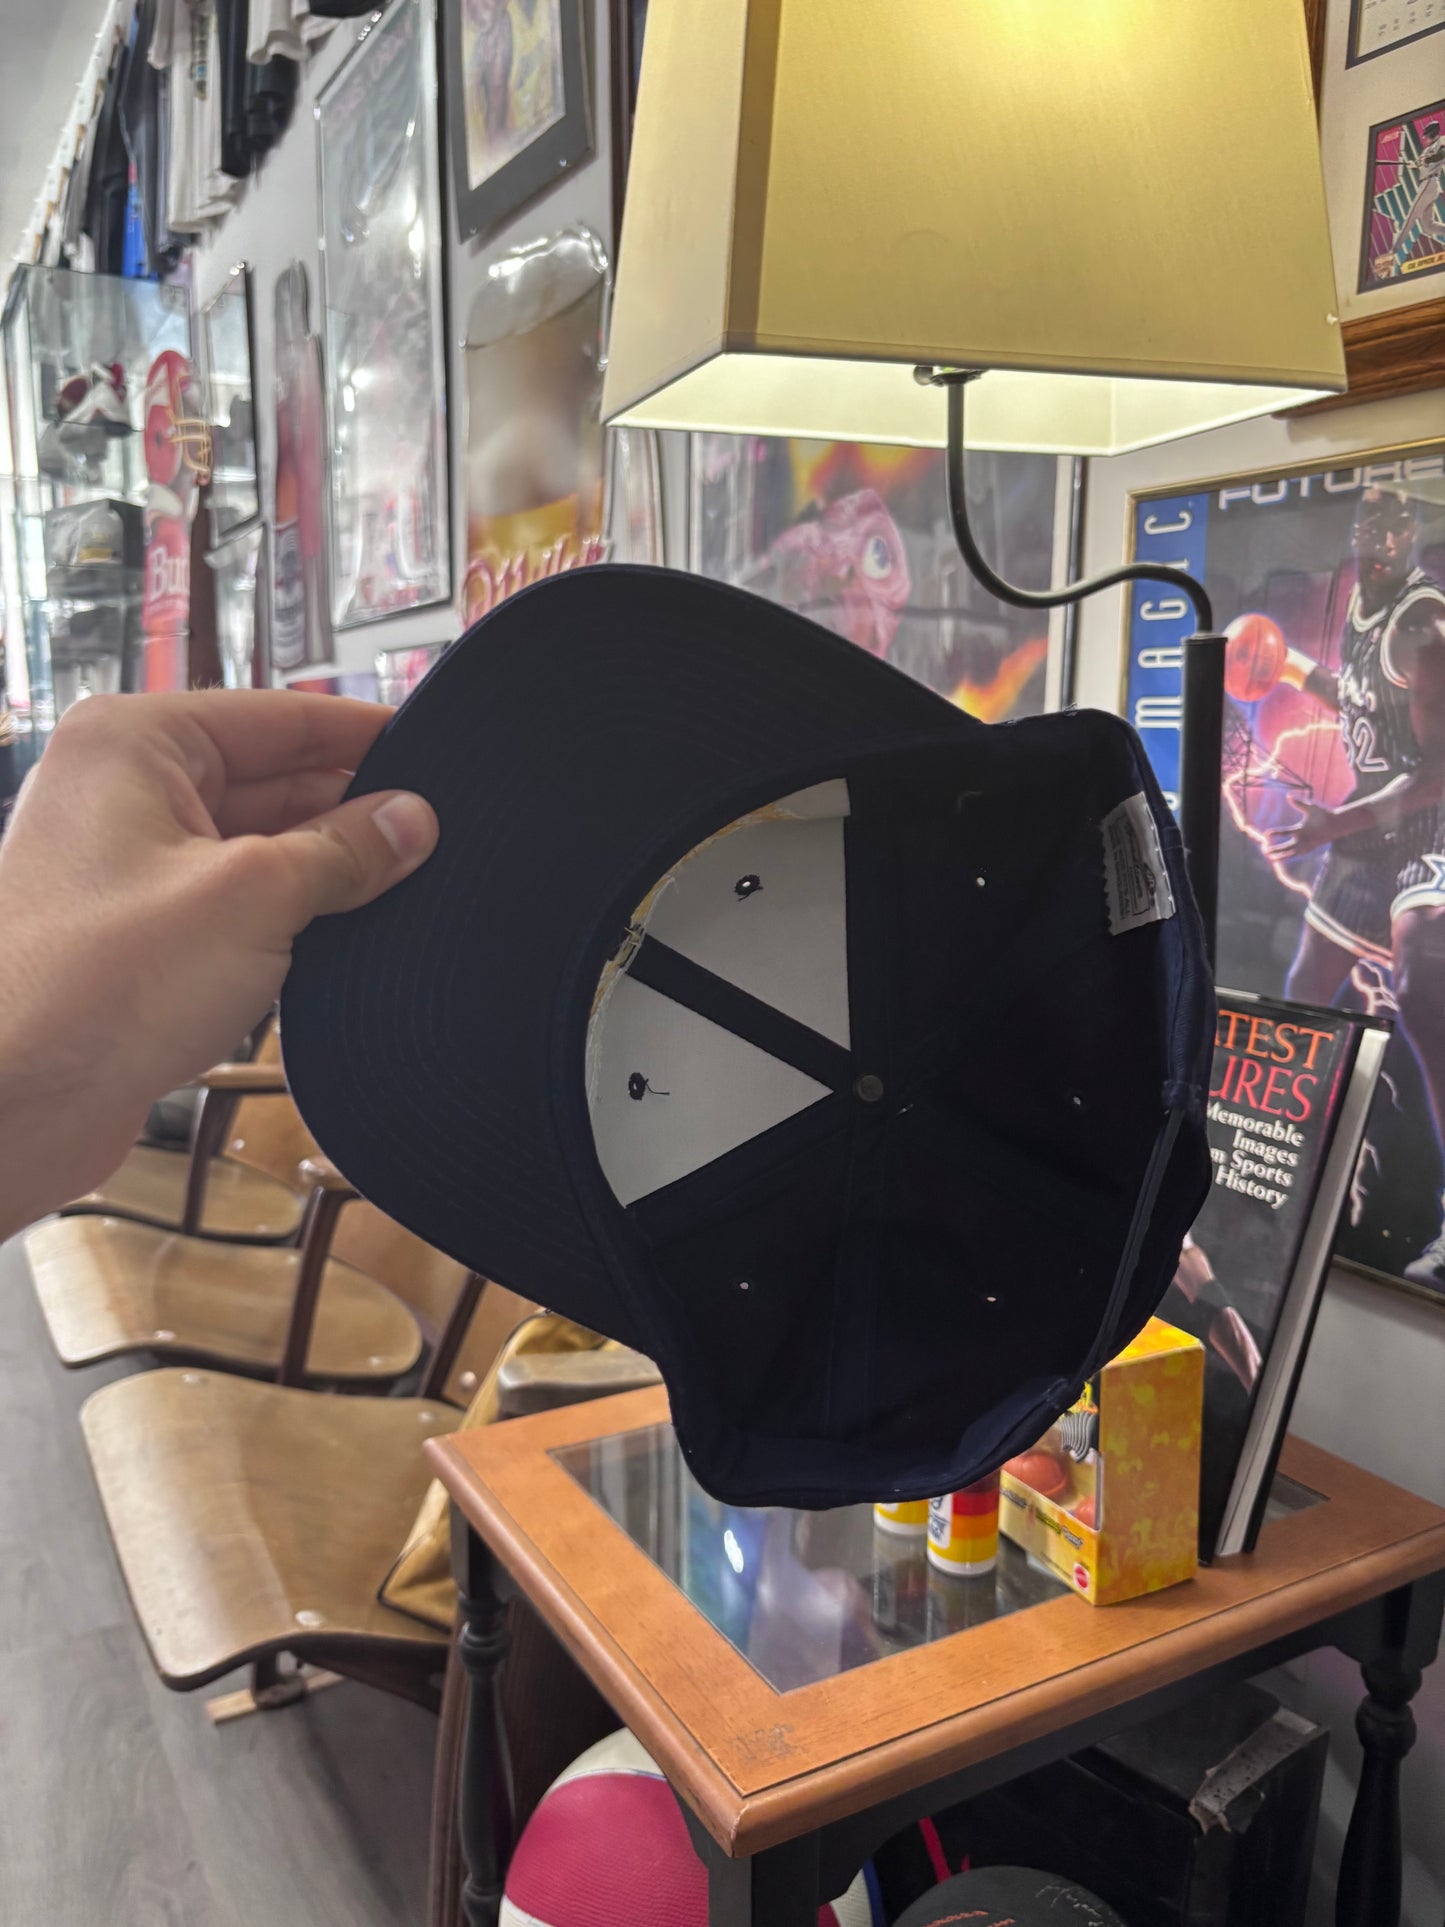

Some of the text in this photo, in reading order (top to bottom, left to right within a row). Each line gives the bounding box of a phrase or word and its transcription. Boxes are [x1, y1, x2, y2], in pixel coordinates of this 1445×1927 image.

[1214, 1009, 1335, 1070] TEST
[1207, 1101, 1305, 1147] Memorable
[1230, 1149, 1294, 1187] Sports
[1232, 1128, 1299, 1167] Images
[1215, 1165, 1289, 1210] History
